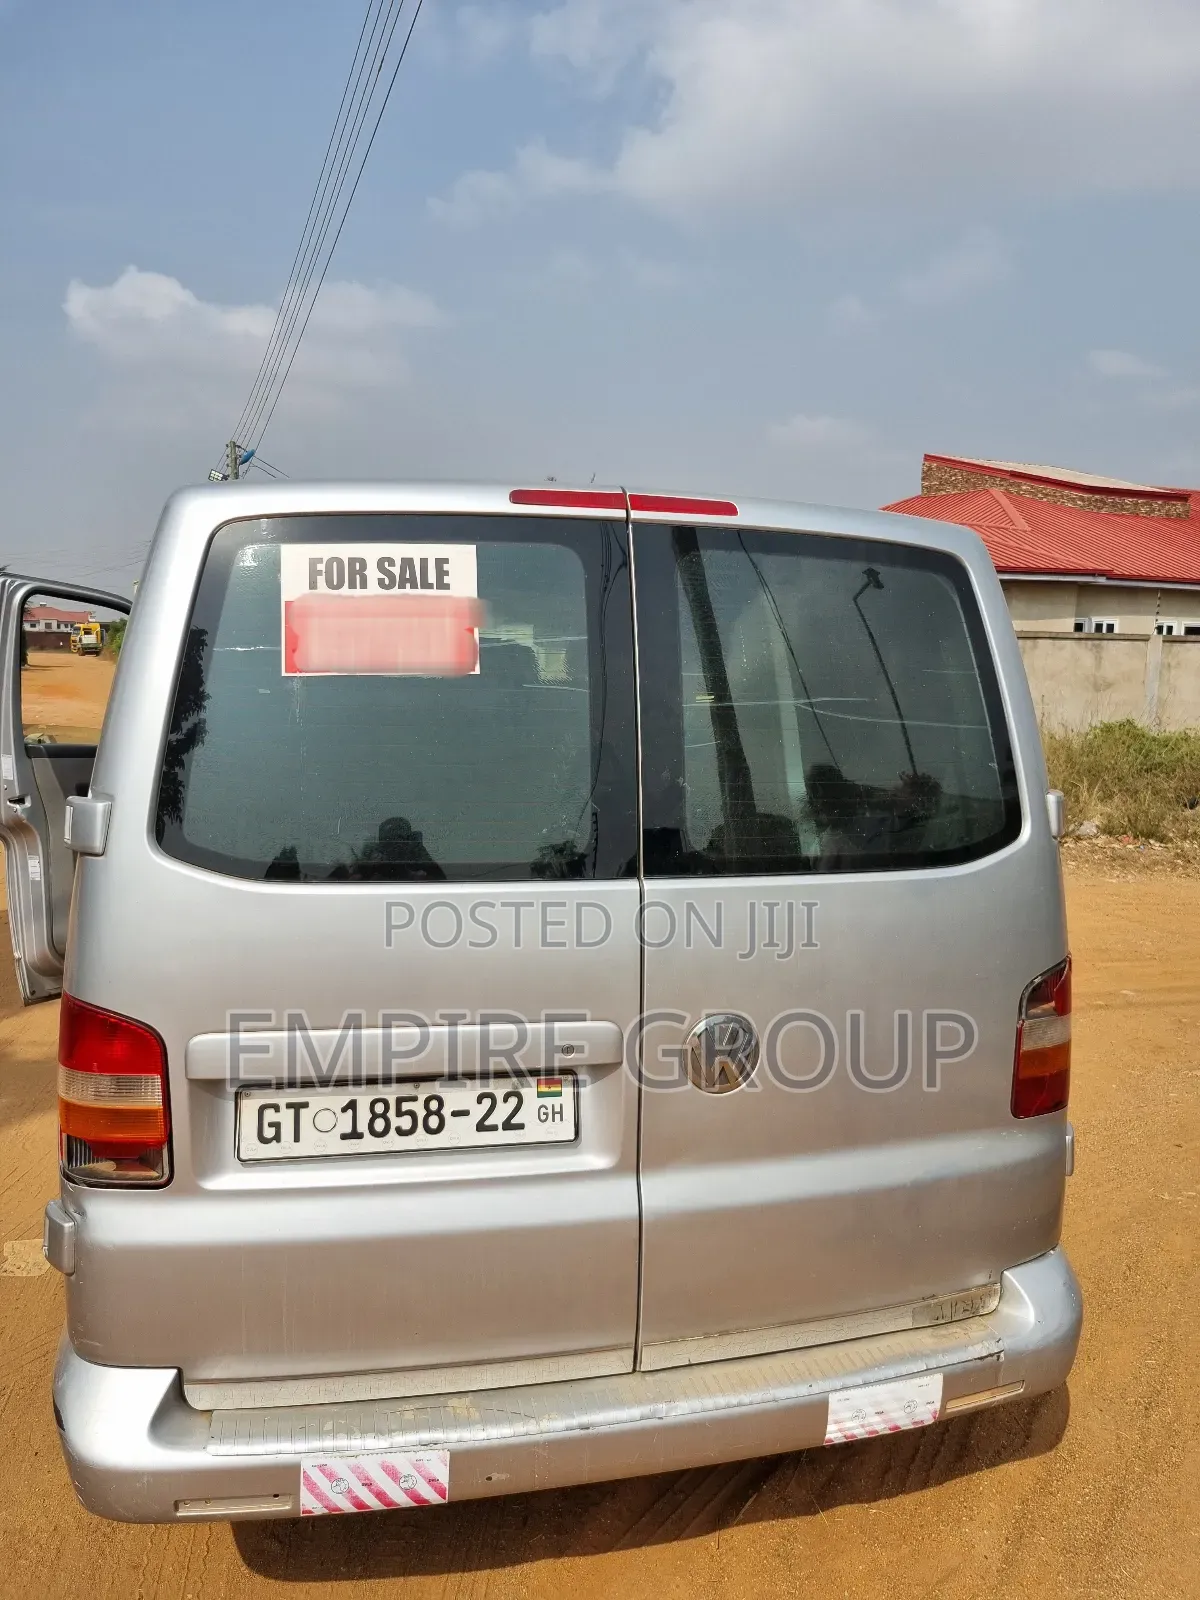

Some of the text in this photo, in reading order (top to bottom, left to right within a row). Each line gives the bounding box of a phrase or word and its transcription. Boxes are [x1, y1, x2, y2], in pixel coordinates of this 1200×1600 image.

[308, 556, 451, 590] FOR SALE
[257, 1090, 526, 1145] GT 1858-22
[537, 1103, 564, 1124] GH
